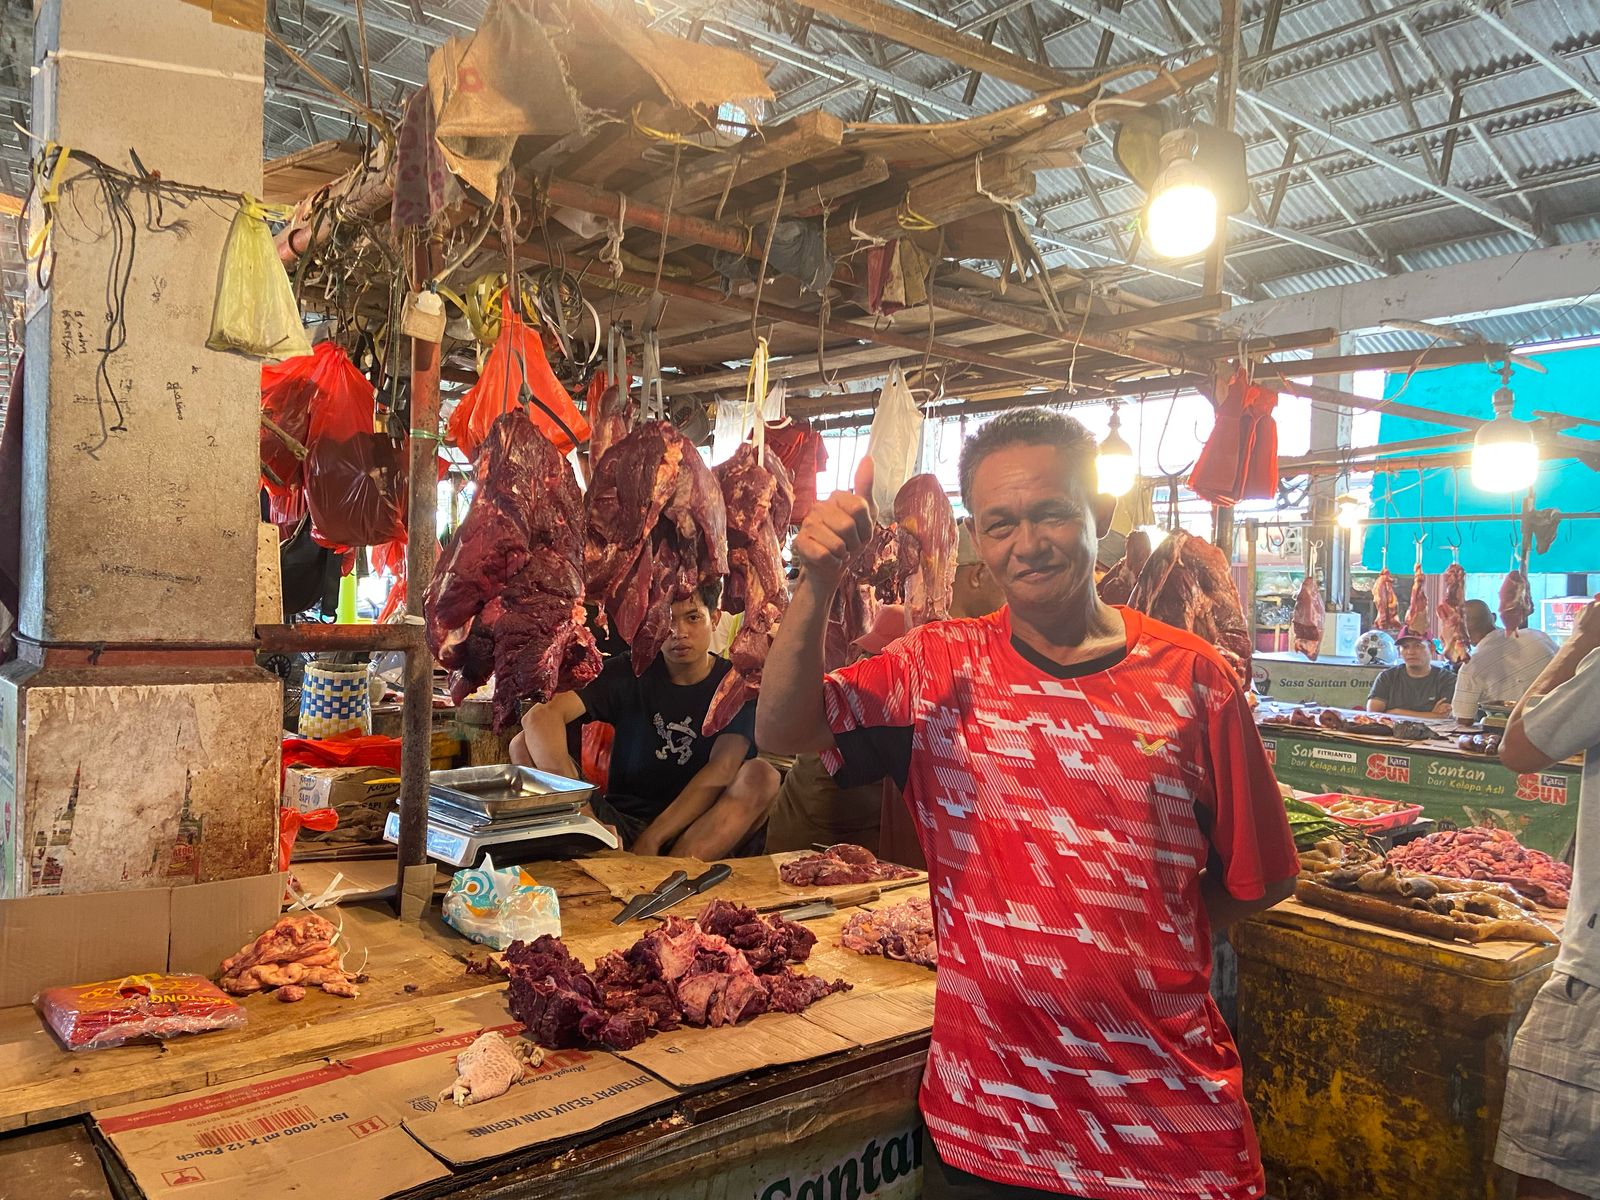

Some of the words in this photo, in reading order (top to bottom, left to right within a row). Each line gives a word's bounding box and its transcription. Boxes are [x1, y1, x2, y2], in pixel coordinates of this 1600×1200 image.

[1279, 678, 1304, 688] Sasa
[1307, 678, 1347, 688] Santan
[1317, 749, 1352, 760] FITRIANTO
[1291, 757, 1307, 768] Dari
[1309, 760, 1338, 772] Kelapa
[1339, 764, 1358, 775] Asli
[1365, 752, 1411, 784] SUN
[1388, 756, 1409, 769] kara
[1427, 761, 1487, 782] Santan
[1427, 776, 1447, 787] Dari
[1449, 779, 1482, 792] Kelapa
[1485, 784, 1506, 796] Asli
[1514, 772, 1568, 806] SUN
[1542, 775, 1566, 788] kara
[416, 1039, 459, 1054] Pouch
[518, 1073, 553, 1088] Goreng
[592, 1074, 654, 1102] DITEMPAT
[548, 1096, 595, 1117] SEJUK
[330, 1112, 350, 1123] ISI
[523, 1108, 552, 1124] DAN
[286, 1121, 318, 1137] 1000
[468, 1117, 523, 1139] KERING
[262, 1132, 281, 1144] ml
[226, 1142, 245, 1152] 12
[175, 1148, 224, 1162] Pouch
